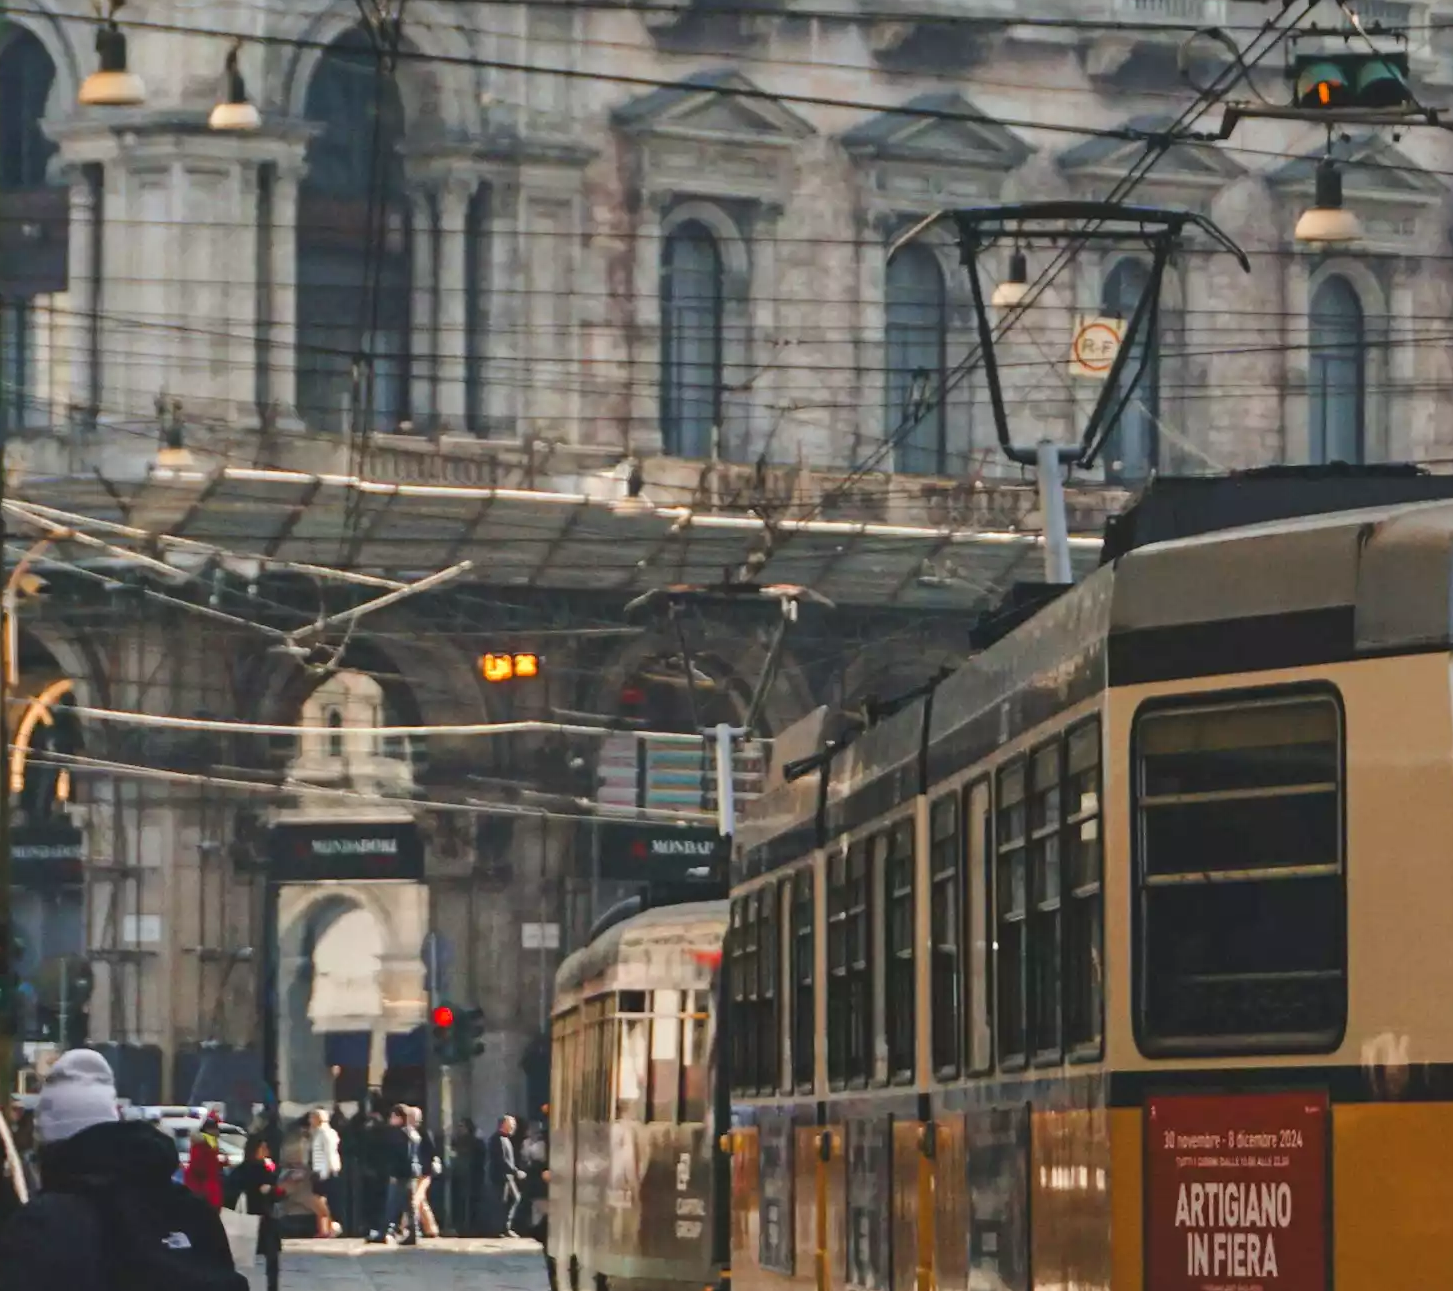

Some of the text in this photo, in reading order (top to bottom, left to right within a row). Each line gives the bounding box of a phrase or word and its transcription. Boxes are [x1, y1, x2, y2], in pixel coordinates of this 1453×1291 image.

[1279, 1129, 1303, 1148] 2024
[1175, 1182, 1293, 1227] ARTIGIANO
[1187, 1232, 1279, 1277] IN FIERA
